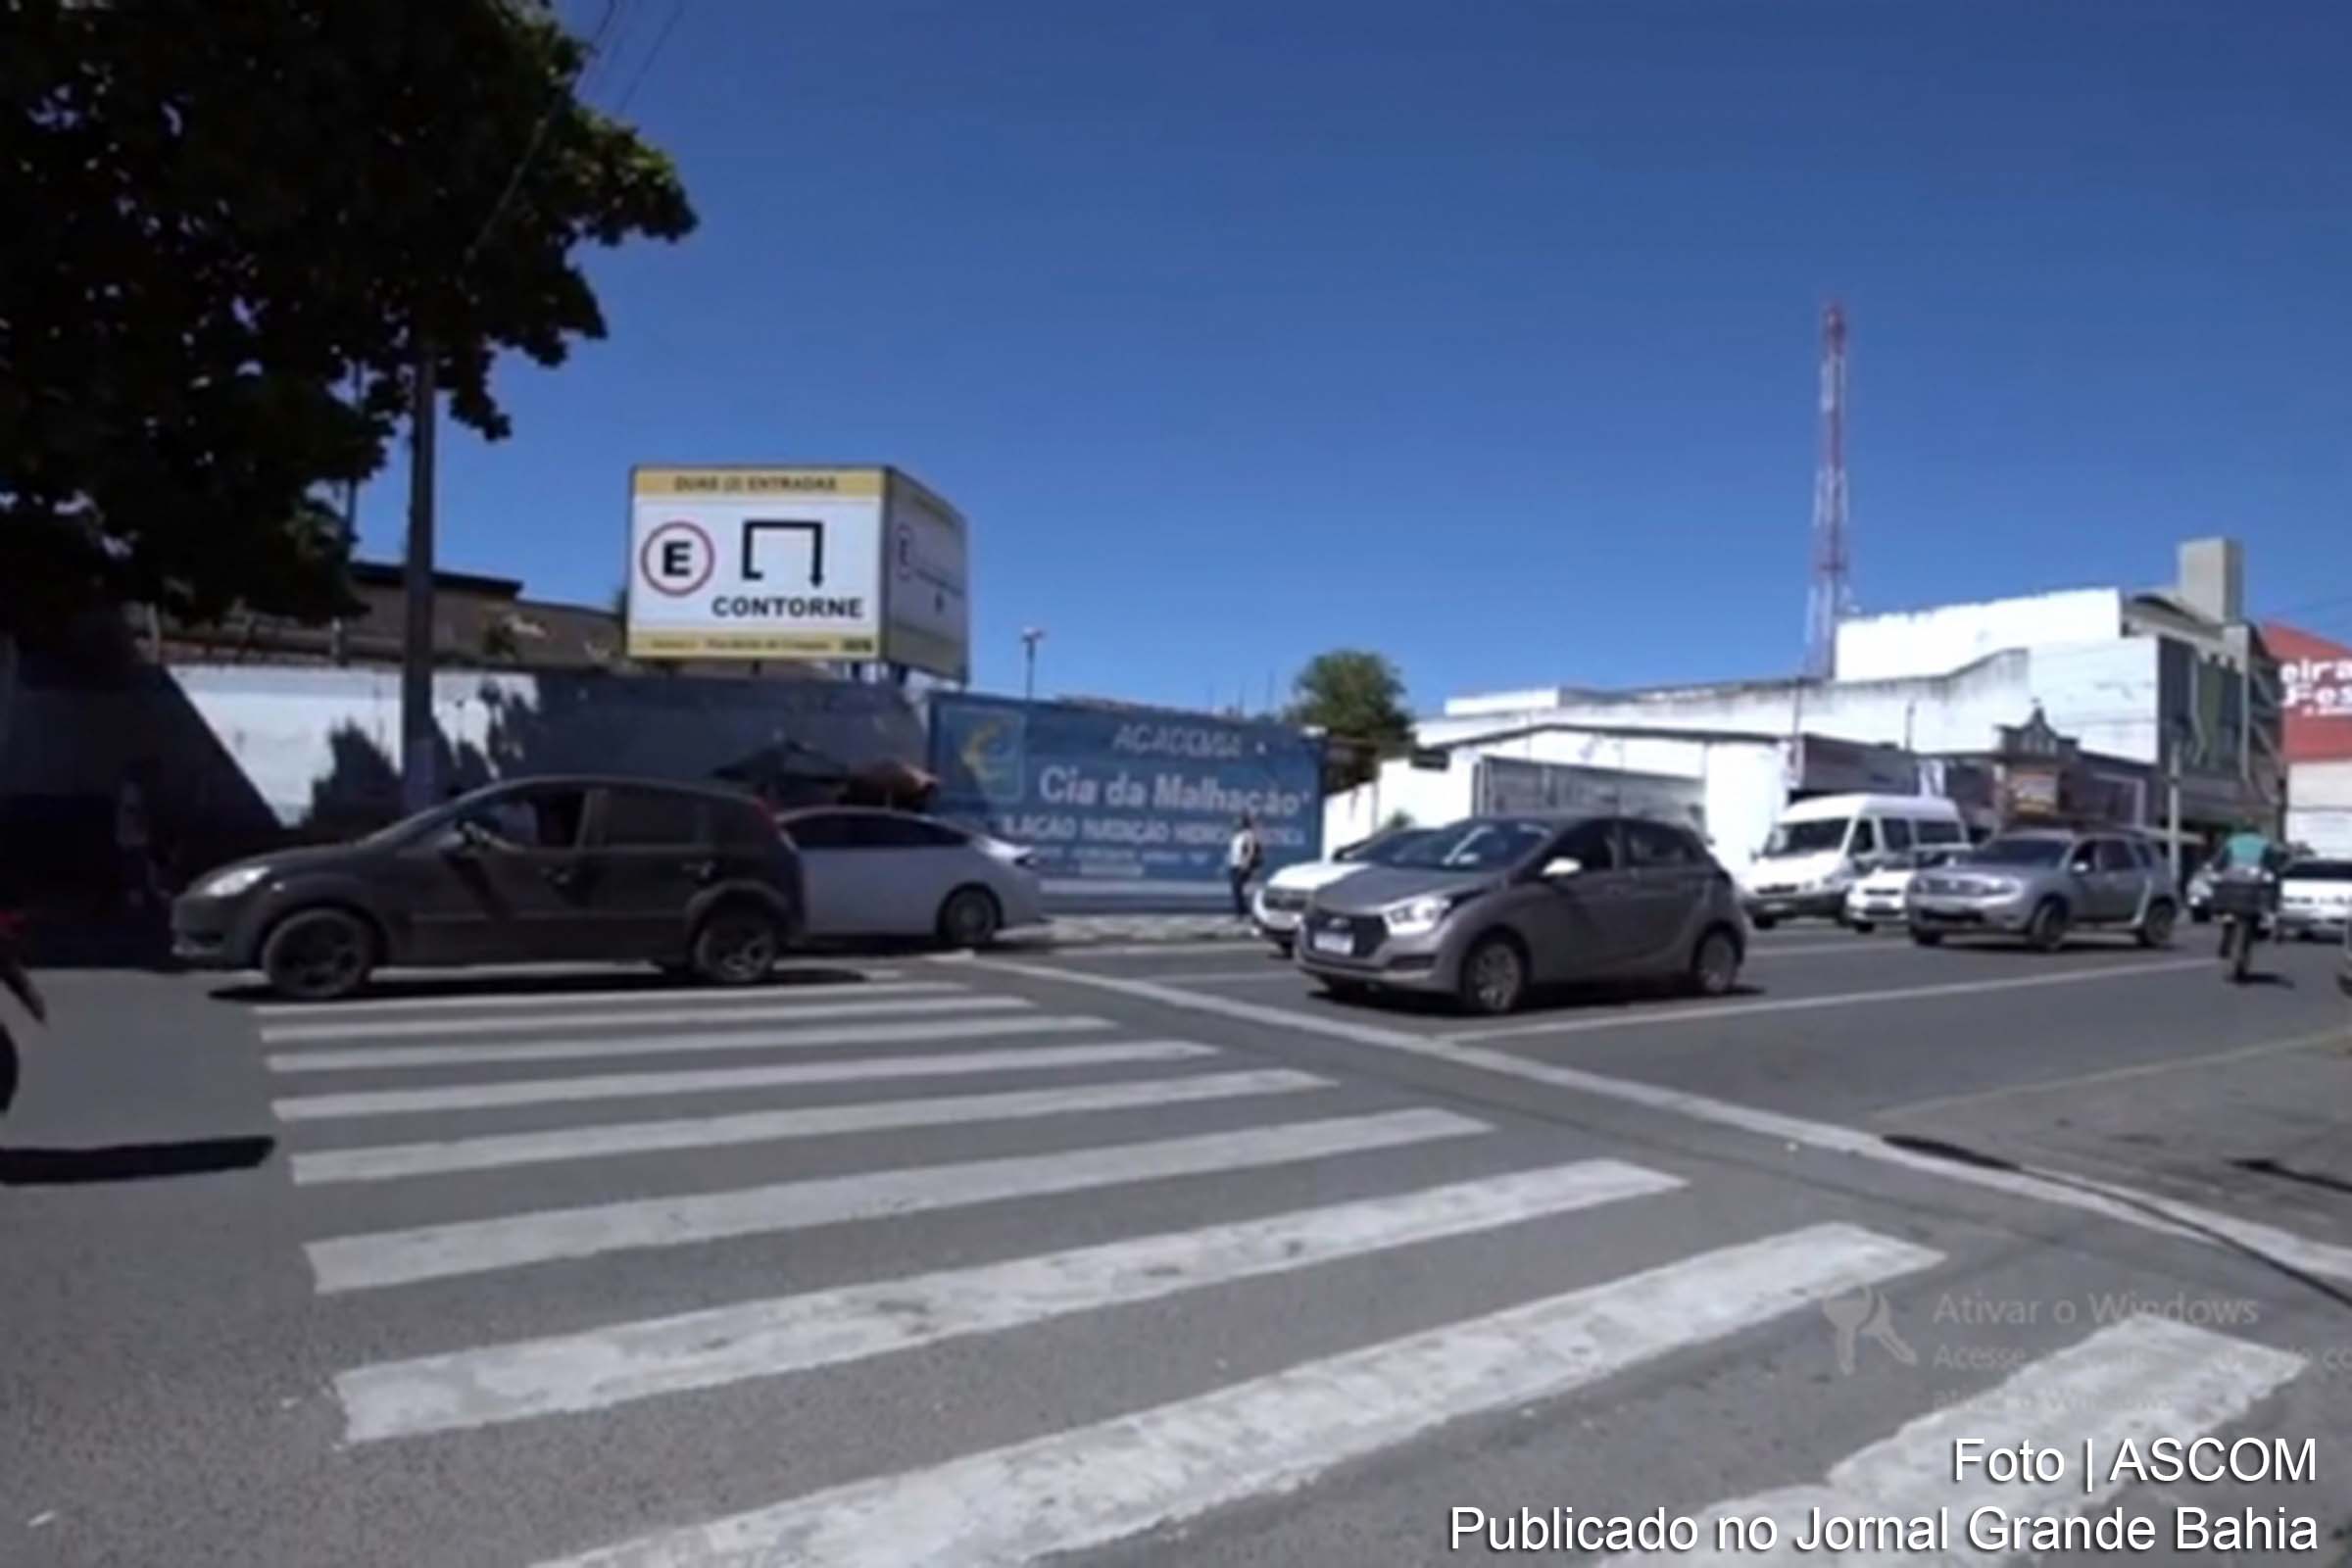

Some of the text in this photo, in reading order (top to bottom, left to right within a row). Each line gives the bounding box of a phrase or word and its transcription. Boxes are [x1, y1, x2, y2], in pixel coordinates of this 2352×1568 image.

[675, 475, 718, 491] DUAS
[748, 475, 836, 491] ENTRADAS
[662, 541, 692, 576] E
[711, 596, 863, 618] CONTORNE
[1039, 765, 1300, 818] Cia da Malhação
